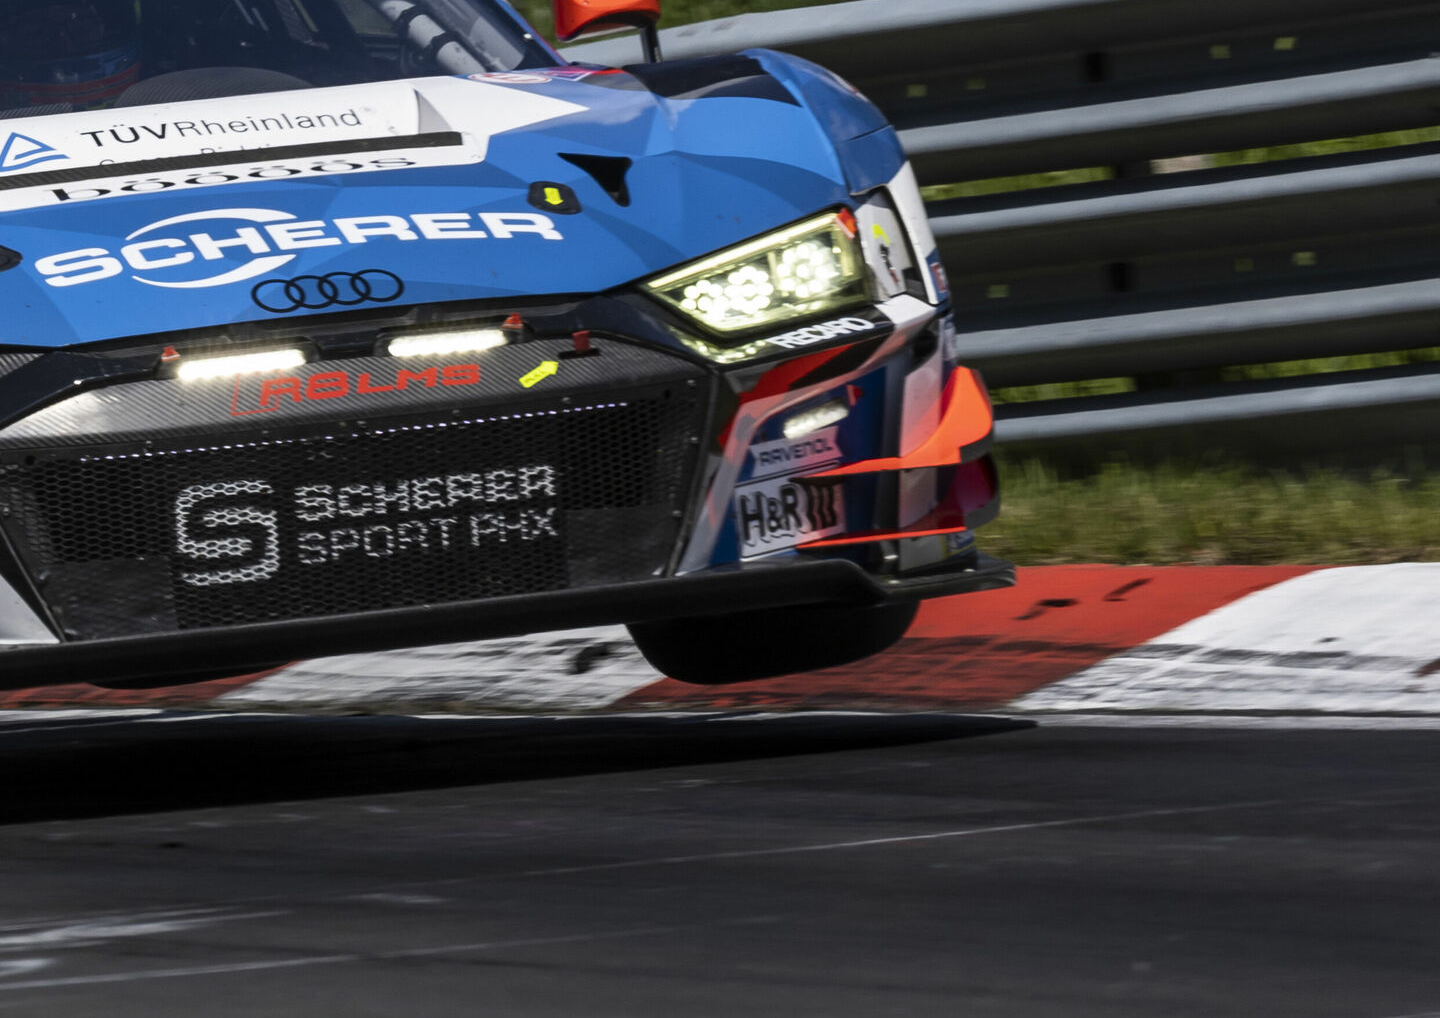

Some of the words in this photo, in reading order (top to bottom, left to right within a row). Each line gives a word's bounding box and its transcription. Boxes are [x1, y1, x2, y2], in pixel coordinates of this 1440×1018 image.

[34, 212, 564, 287] SCHERER
[766, 317, 875, 349] RECARO
[294, 465, 558, 522] SCHERER
[740, 484, 804, 542] H&R
[296, 517, 459, 565] SPORT
[469, 507, 559, 548] PHX
